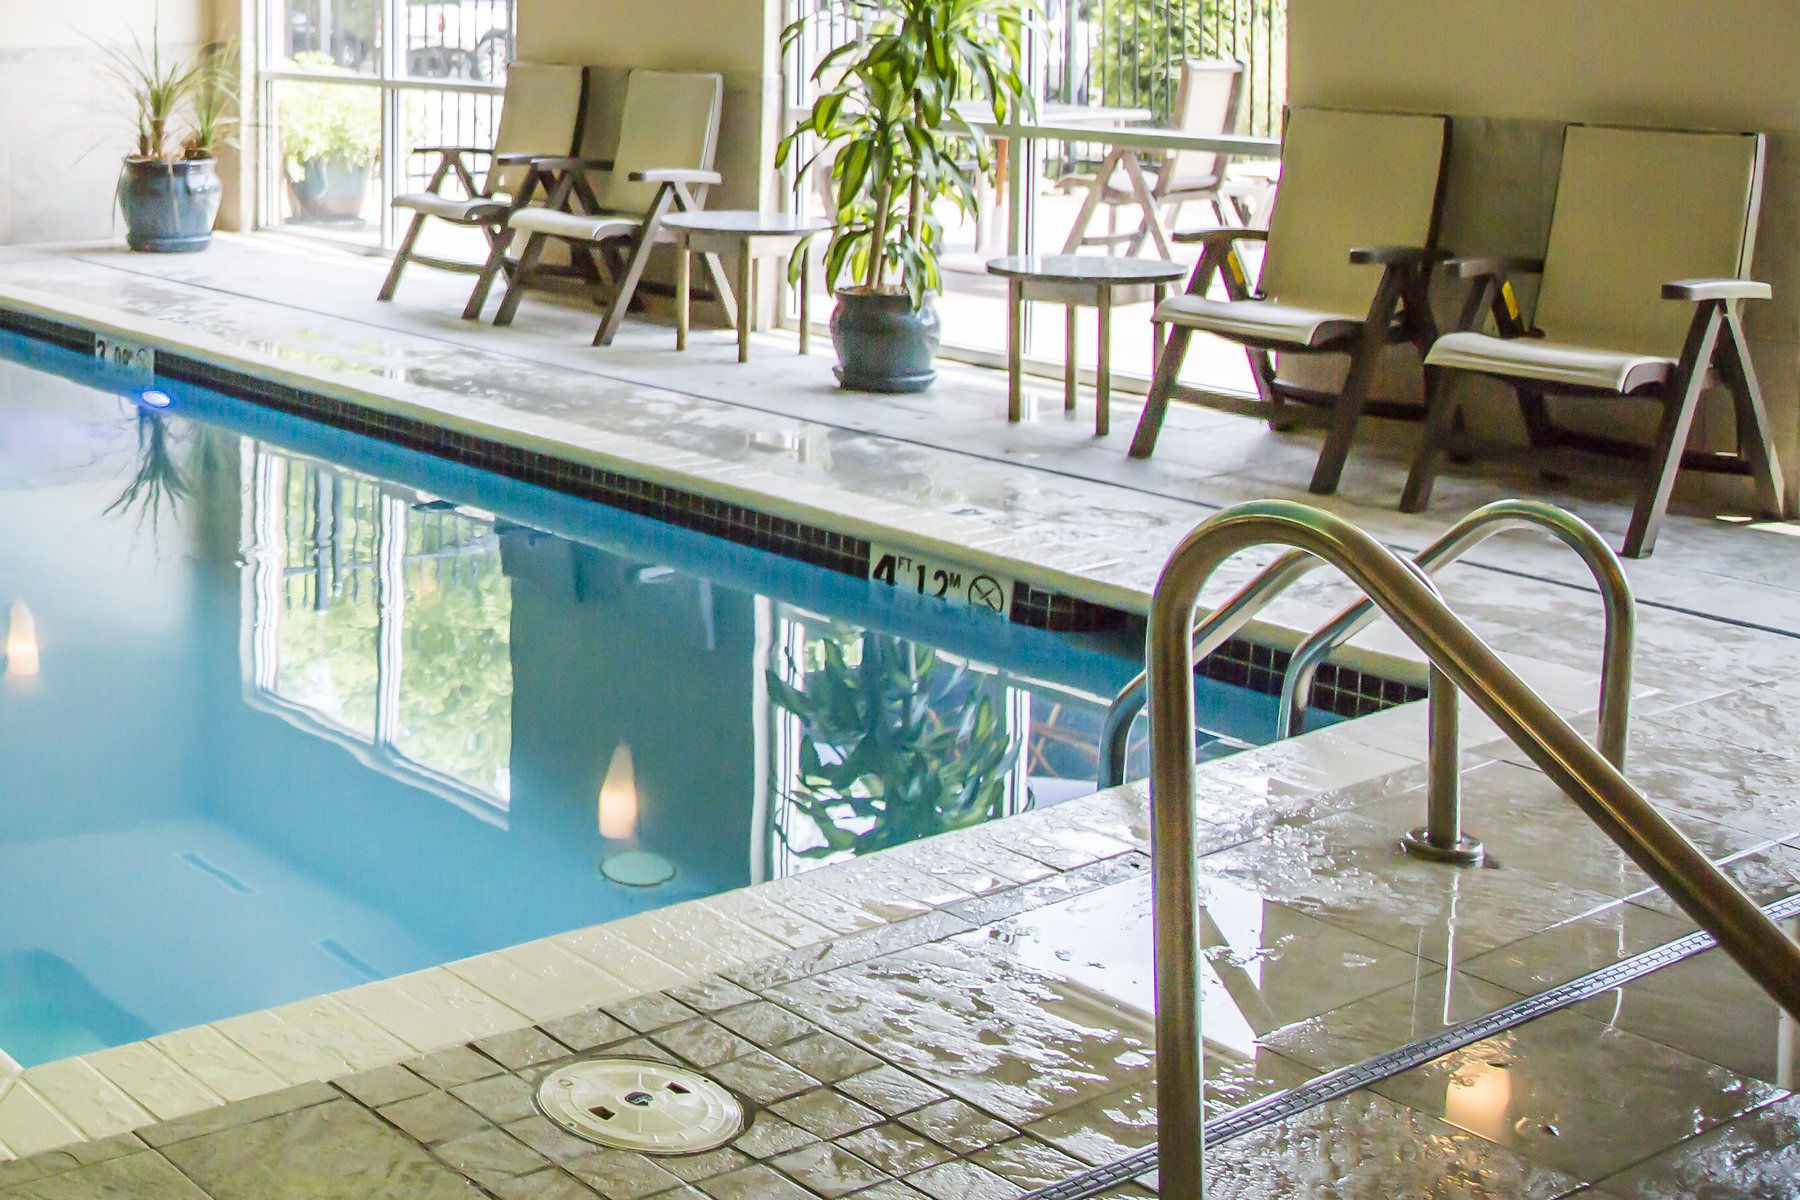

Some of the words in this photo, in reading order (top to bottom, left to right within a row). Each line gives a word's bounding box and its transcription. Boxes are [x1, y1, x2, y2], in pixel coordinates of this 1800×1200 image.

[873, 554, 897, 585] 4
[898, 556, 913, 572] FT
[949, 572, 961, 589] M
